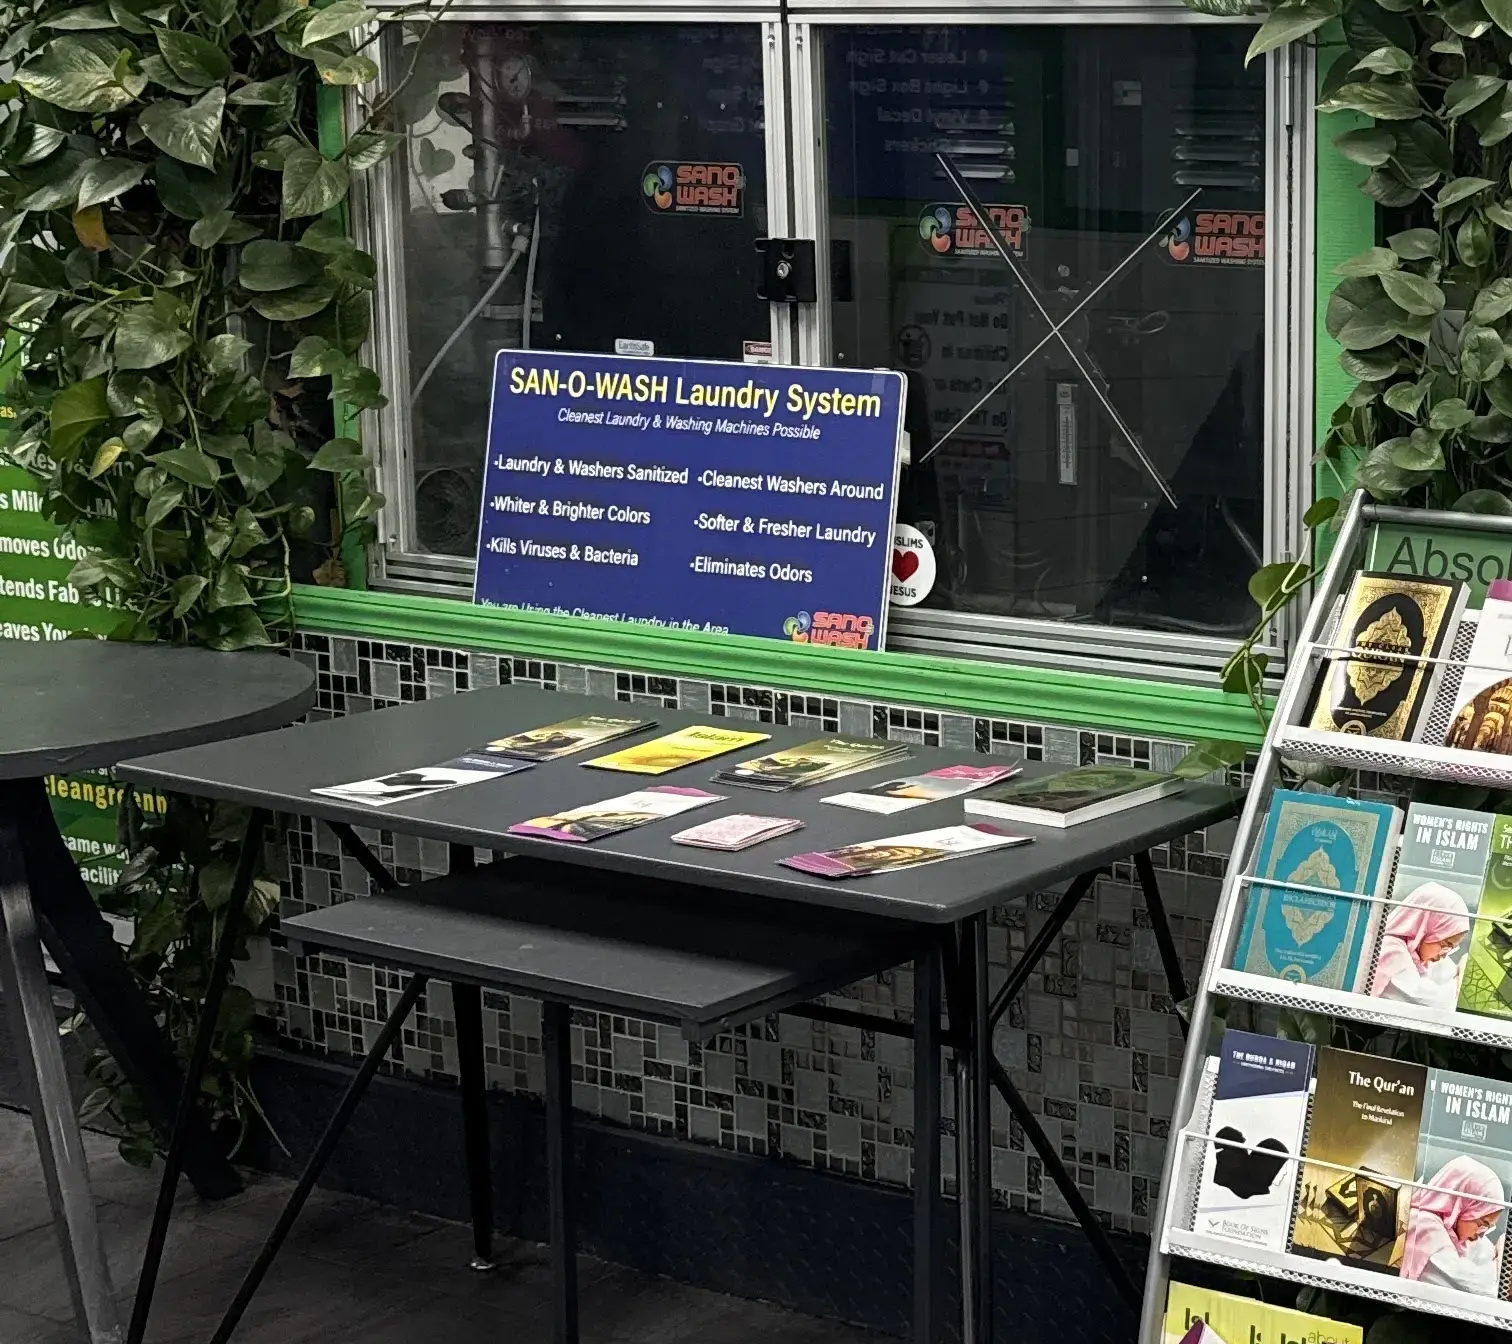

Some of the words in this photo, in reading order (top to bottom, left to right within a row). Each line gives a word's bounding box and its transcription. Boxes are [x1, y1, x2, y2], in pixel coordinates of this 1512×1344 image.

[676, 186, 737, 206] WASH
[956, 228, 1021, 250] WAH
[1194, 235, 1264, 257] WASH
[510, 367, 668, 404] SAN-O-WASH
[675, 377, 779, 418] Laundry
[786, 384, 880, 420] System
[558, 408, 604, 425] Cleanest
[606, 411, 651, 431] Laundry
[653, 415, 661, 428] &
[665, 416, 713, 435] Washing
[715, 419, 770, 436] Machines
[772, 423, 821, 439] Possible
[554, 459, 564, 474] &
[569, 460, 624, 479] Washers
[627, 464, 689, 484] Sanitized
[767, 475, 826, 496] Washers
[830, 481, 884, 500] Around
[538, 500, 549, 515] &
[553, 501, 605, 522] Brighter
[607, 505, 651, 524] Colors
[743, 517, 755, 534] &
[758, 519, 812, 539] Fresher
[816, 523, 876, 548] Laundry
[0, 536, 50, 557] moves
[520, 540, 566, 559] Viruses
[570, 545, 580, 560] &
[584, 546, 638, 566] Bacteria
[769, 564, 813, 583] Odors
[703, 622, 728, 635] Area
[811, 629, 869, 649] WASH
[1455, 820, 1489, 834] RIGHTS
[1416, 827, 1431, 845] IN
[1435, 831, 1479, 851] ISLAM
[1349, 1070, 1371, 1088] The
[1446, 1096, 1462, 1115] IN
[1465, 1099, 1511, 1125] ISLAM
